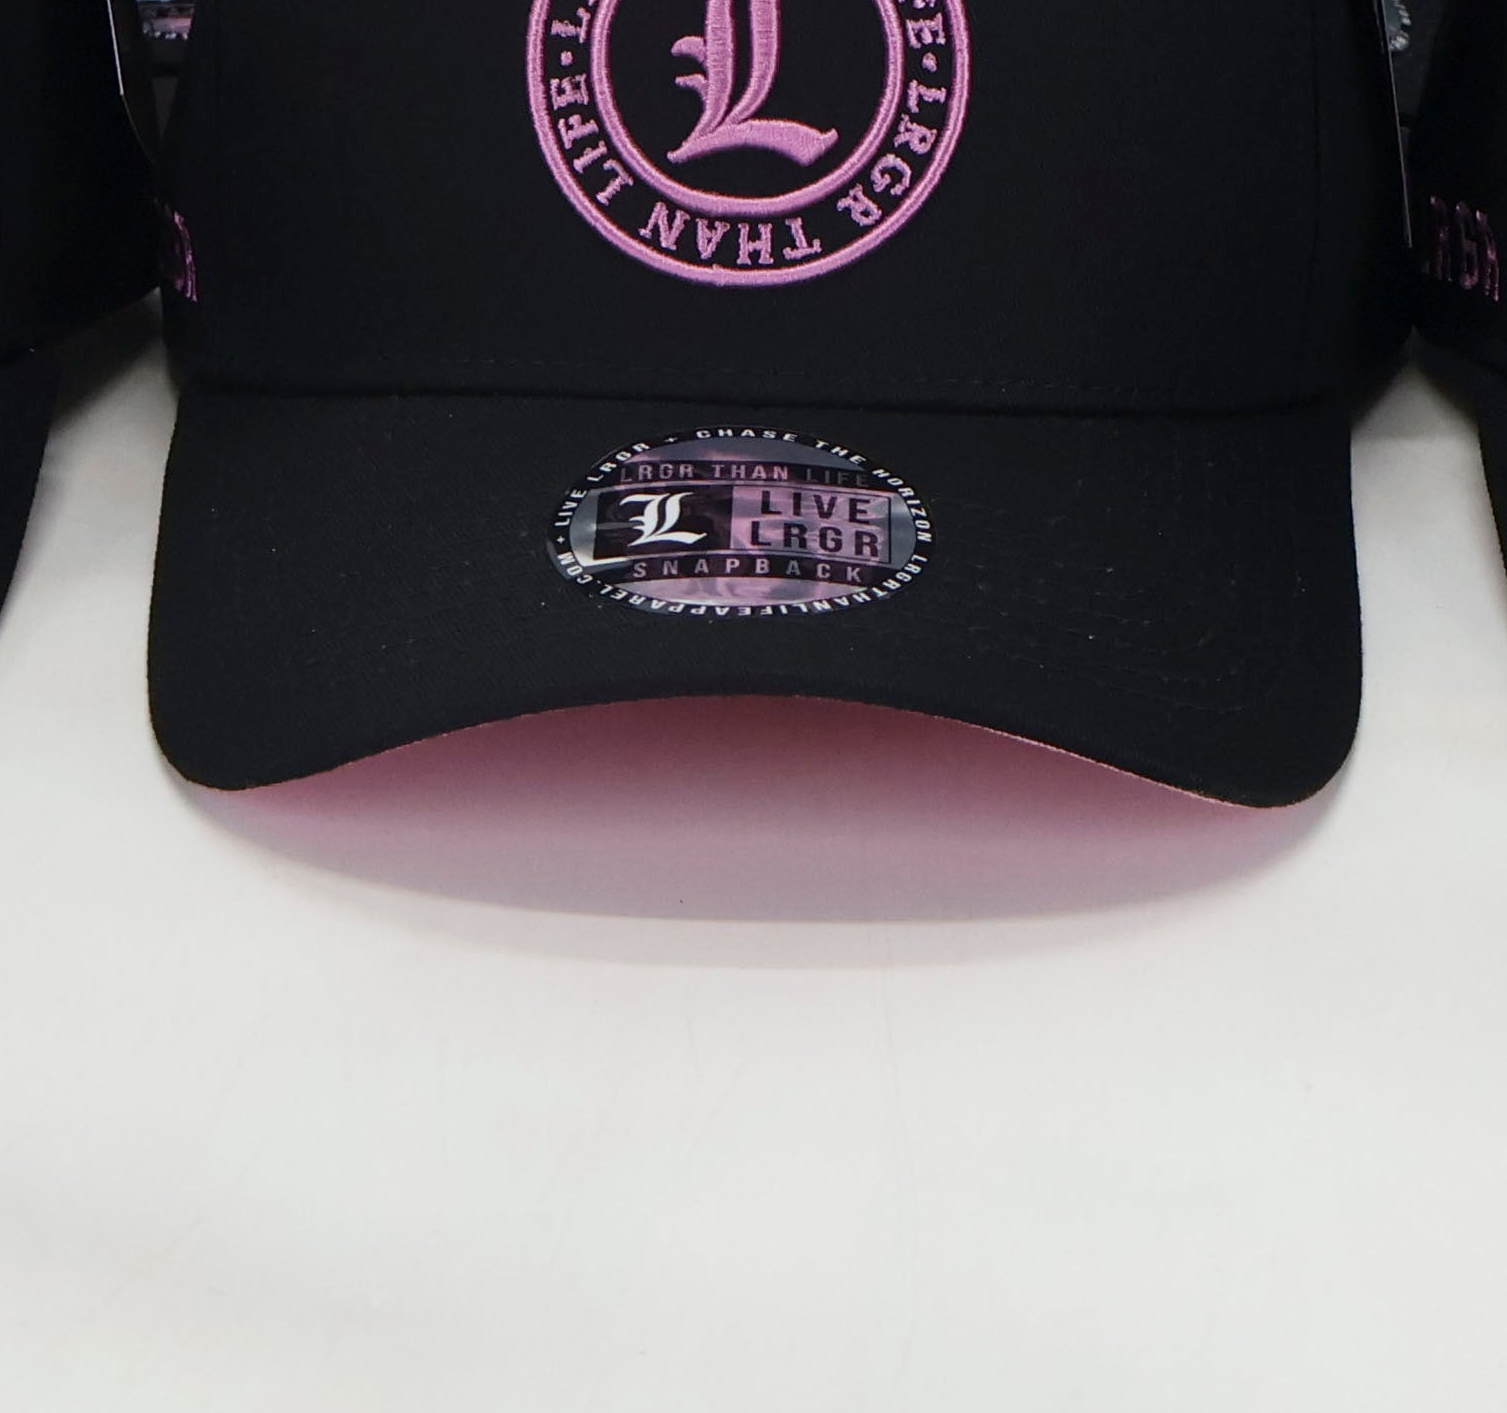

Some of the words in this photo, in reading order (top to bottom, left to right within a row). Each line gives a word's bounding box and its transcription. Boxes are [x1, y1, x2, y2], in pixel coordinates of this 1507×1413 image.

[550, 74, 633, 205] LIFE
[837, 80, 946, 226] LRGR
[639, 201, 822, 265] THAN
[554, 488, 587, 527] LIVE
[590, 441, 652, 483] LRGR
[619, 463, 694, 483] LRGR
[711, 463, 790, 481] THAN
[805, 468, 870, 487] LIFE
[695, 427, 798, 443] CHASE
[814, 439, 867, 464] THE
[872, 467, 933, 543] HORIZON
[618, 491, 708, 547] L
[760, 490, 871, 524] LIVE
[750, 520, 880, 558] LRGR
[631, 557, 864, 584] SNAPBACK
